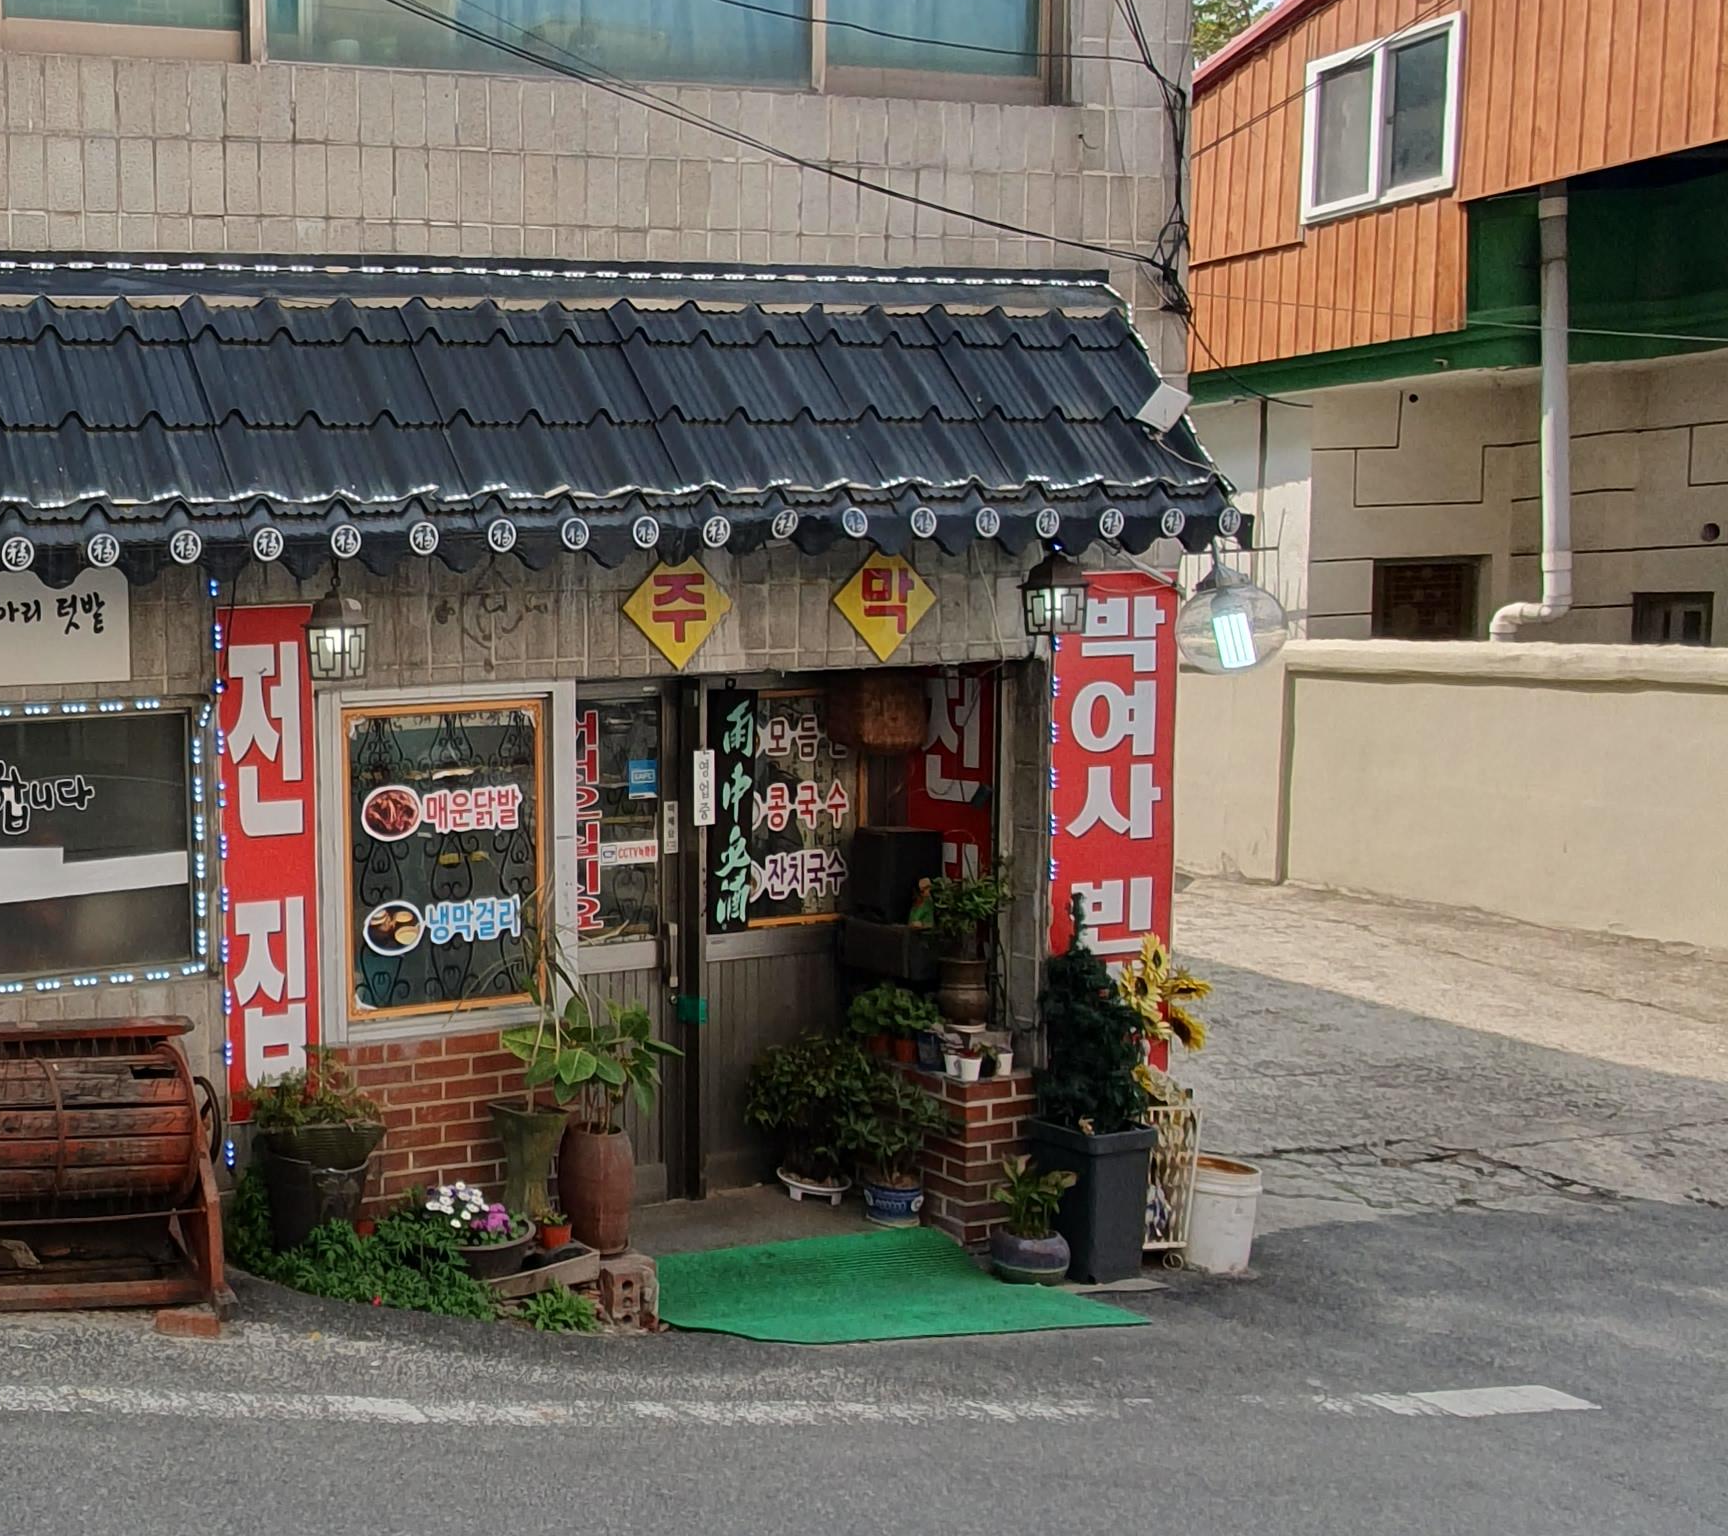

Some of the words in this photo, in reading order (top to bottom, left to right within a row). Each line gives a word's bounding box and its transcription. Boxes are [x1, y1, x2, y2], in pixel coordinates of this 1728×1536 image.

[56, 591, 107, 635] 텃밭
[652, 572, 706, 643] 주
[862, 568, 915, 635] 막
[767, 717, 848, 759] 모듬
[1066, 595, 1166, 841] 박여사
[425, 788, 519, 830] 매운닭발
[767, 782, 847, 829] 콩국수
[767, 852, 846, 898] 잔치국수
[428, 898, 520, 941] 냉막걸리
